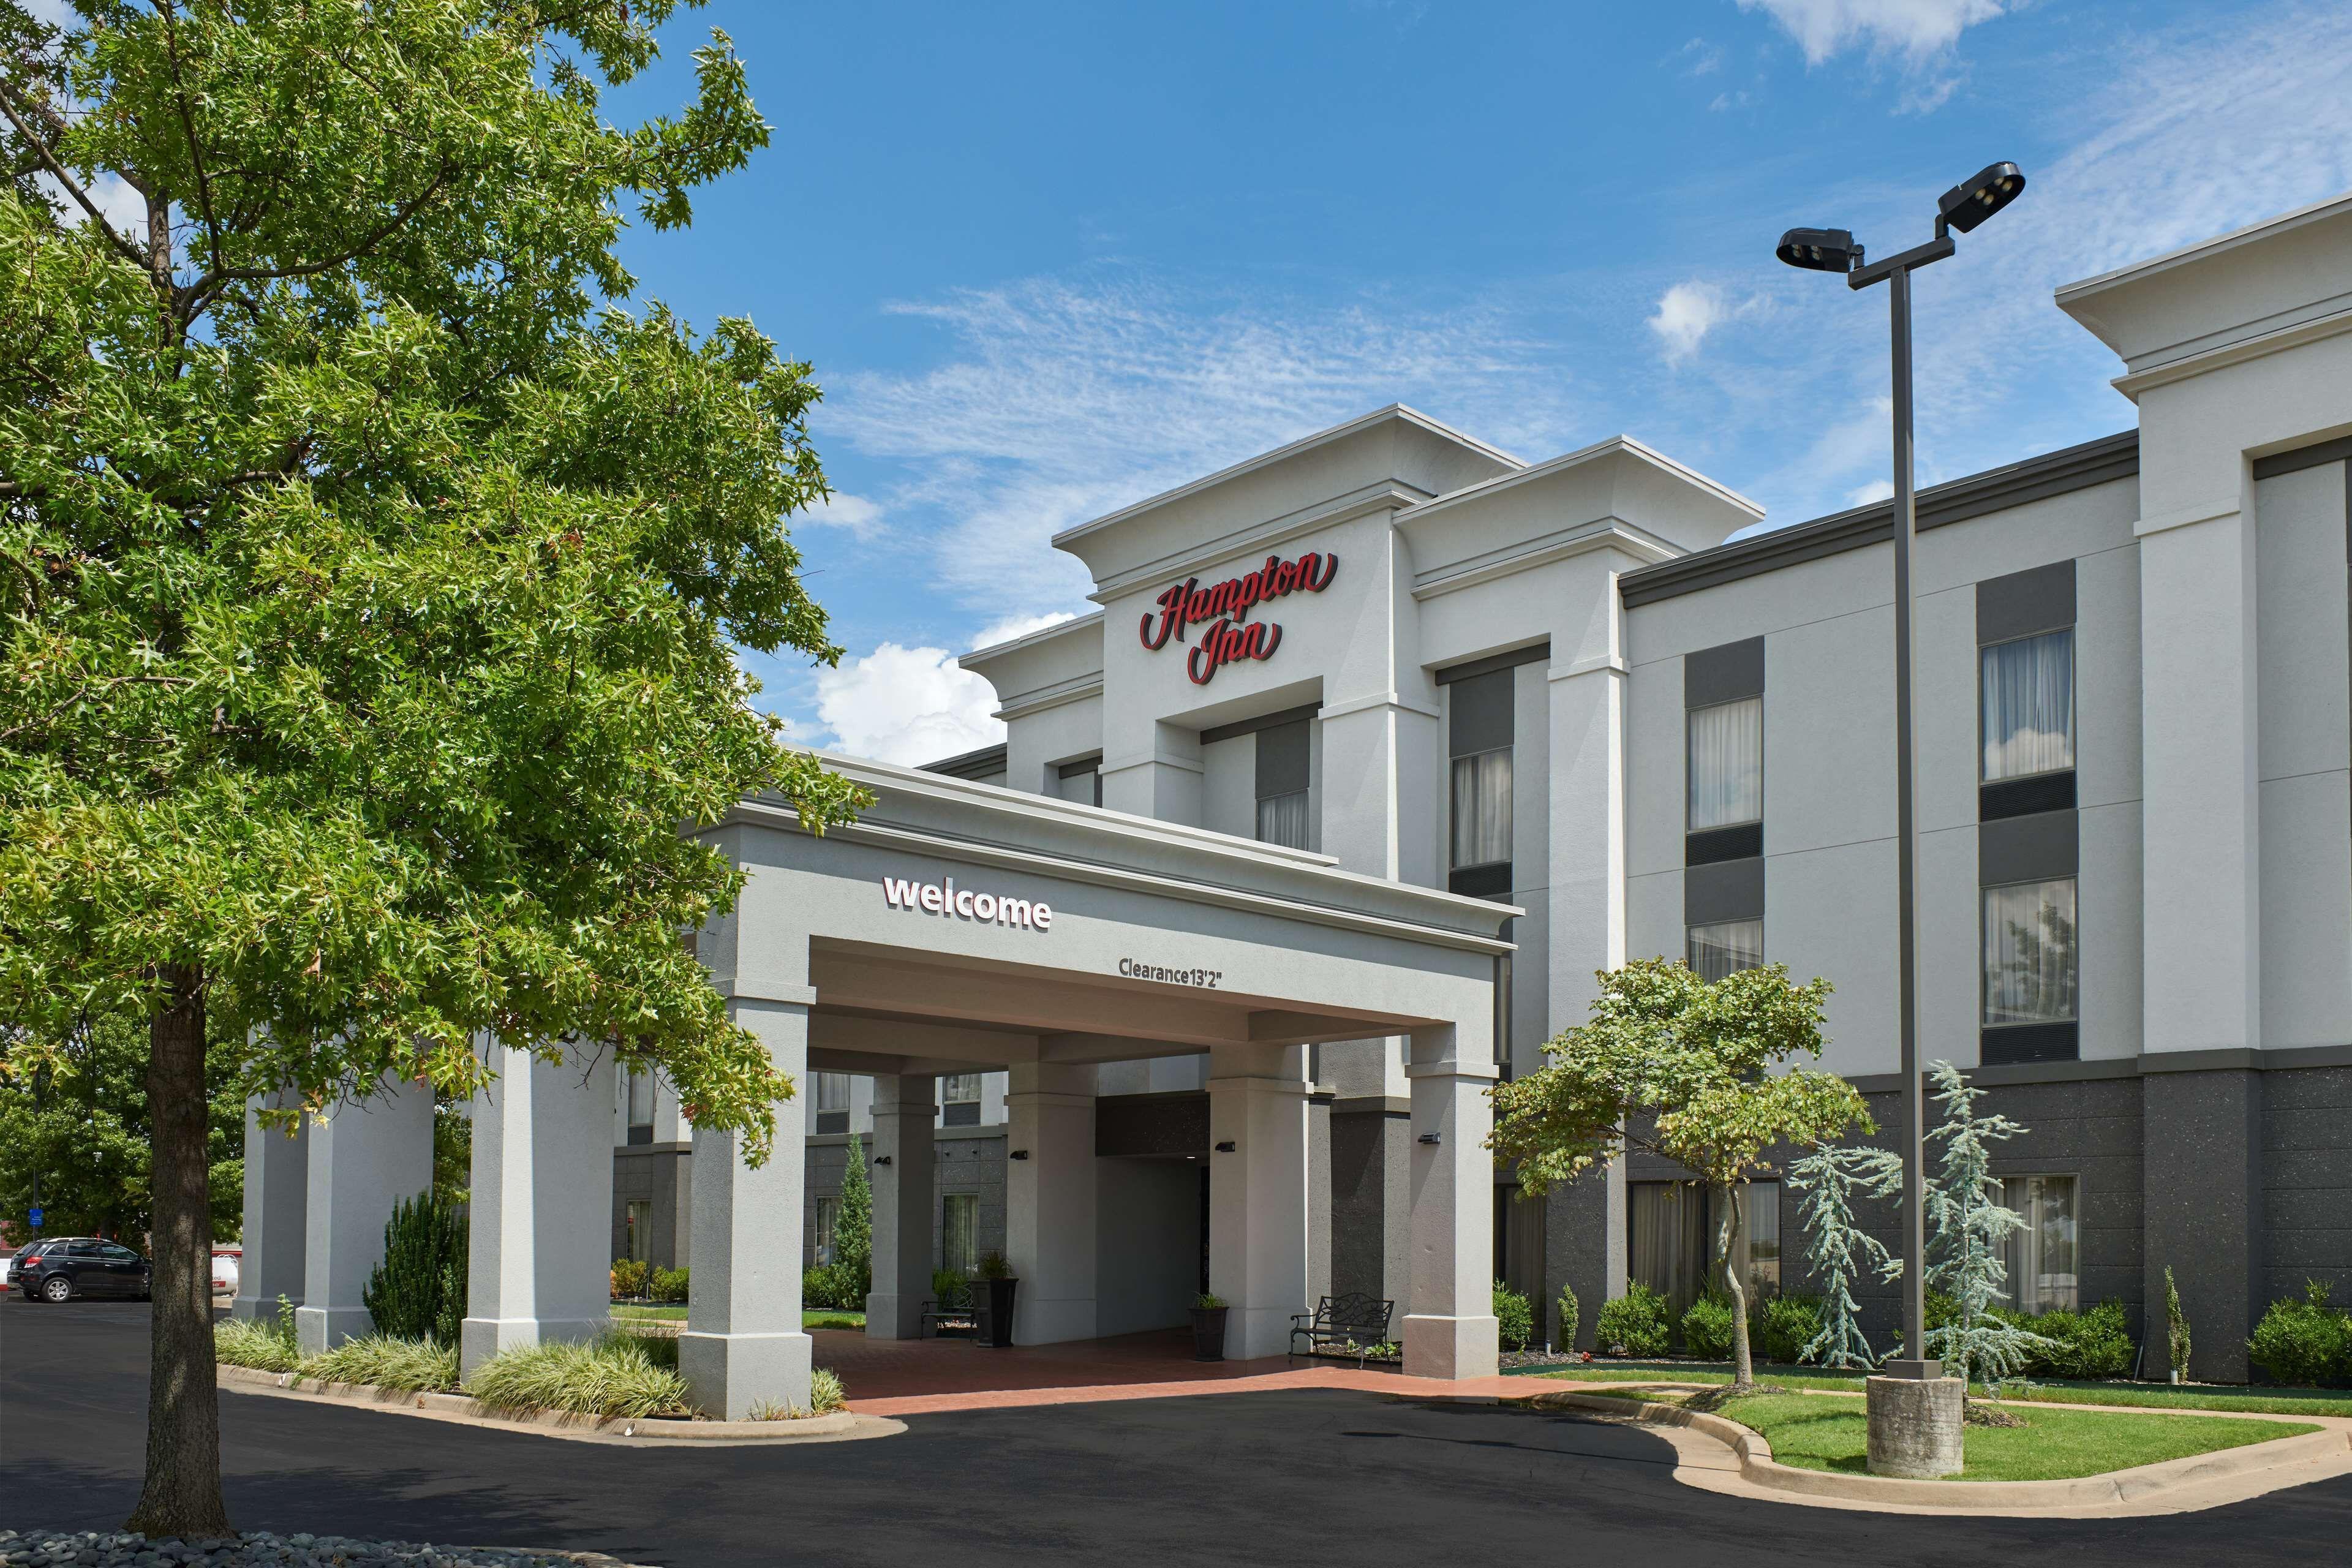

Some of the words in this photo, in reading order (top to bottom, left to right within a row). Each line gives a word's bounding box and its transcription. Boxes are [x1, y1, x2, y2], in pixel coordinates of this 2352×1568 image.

[1140, 552, 1338, 651] Hampton
[1187, 617, 1283, 685] Inn
[882, 876, 1052, 929] welcome
